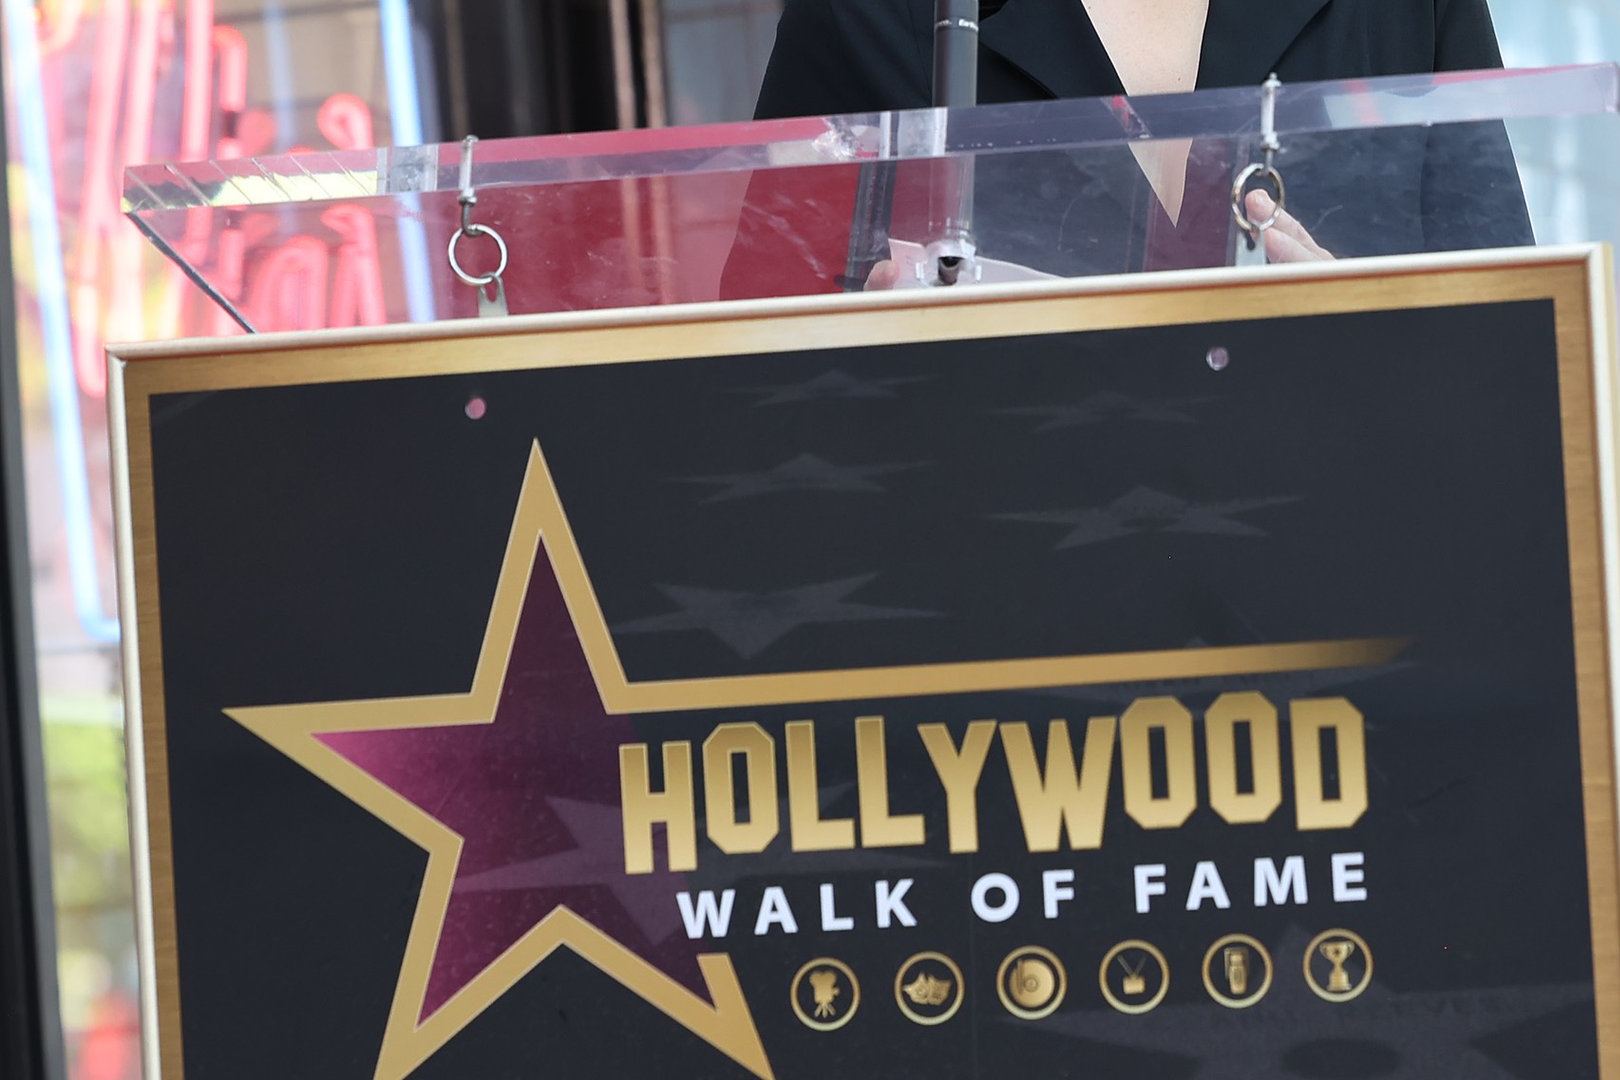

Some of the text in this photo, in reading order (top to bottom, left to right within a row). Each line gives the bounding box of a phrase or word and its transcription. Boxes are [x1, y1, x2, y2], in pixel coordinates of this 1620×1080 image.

[618, 691, 1369, 874] HOLLYWOOD
[676, 852, 1368, 940] WALK OF FAME
